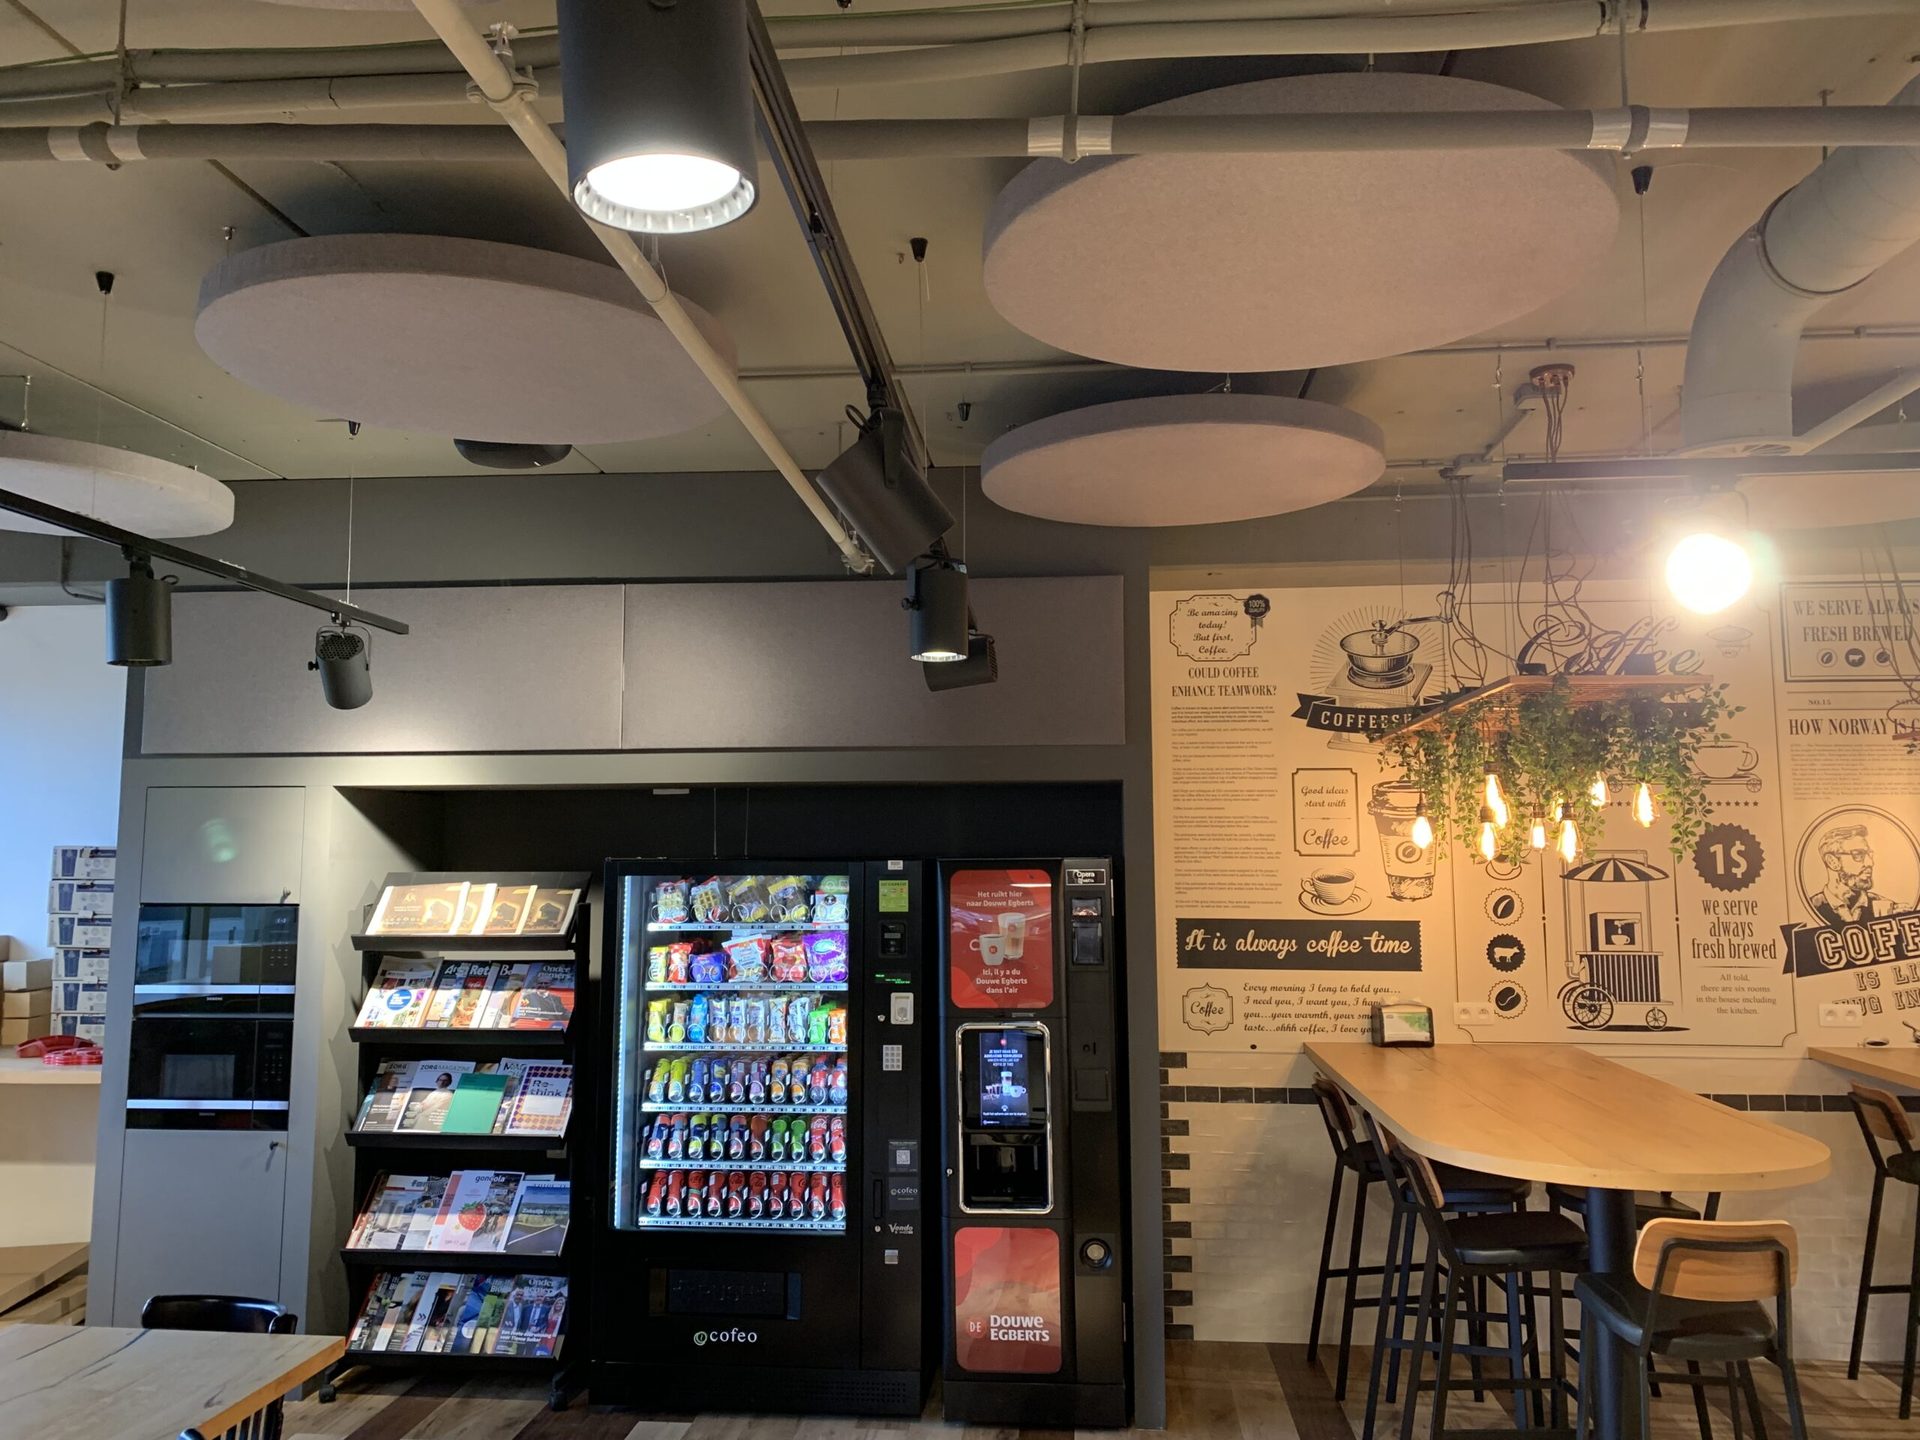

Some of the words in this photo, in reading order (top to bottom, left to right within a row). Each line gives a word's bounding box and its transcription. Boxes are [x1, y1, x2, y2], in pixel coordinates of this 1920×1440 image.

[1186, 608, 1199, 616] Be
[1201, 609, 1238, 617] amazing
[1793, 600, 1815, 616] WE
[1819, 599, 1863, 616] SERVE
[1198, 621, 1227, 631] today!
[1193, 633, 1210, 642] But
[1212, 633, 1234, 643] first,
[1803, 626, 1848, 642] FRESH
[1852, 625, 1913, 642] BREWED
[1188, 667, 1220, 679] COULD
[1223, 666, 1259, 678] COFFEE
[1172, 685, 1216, 697] ENHANCE
[1218, 684, 1277, 696] TEAMWORK?
[1789, 719, 1823, 736] HOW
[1829, 718, 1888, 735] NORWAY
[1300, 786, 1322, 796] Good
[1325, 786, 1349, 795] ideas
[1304, 799, 1324, 808] start
[1326, 799, 1347, 808] with
[1302, 828, 1349, 849] Coffee
[1709, 840, 1748, 878] 1$
[1008, 901, 1034, 909] Egberts
[1702, 900, 1720, 916] we
[1723, 900, 1758, 916] serve
[1709, 916, 1754, 940] always
[1184, 929, 1211, 951] It
[1212, 932, 1227, 951] is
[1235, 930, 1298, 959] always
[1306, 930, 1362, 957] coffee
[1363, 931, 1413, 954] time
[1814, 913, 1920, 969] COFF
[1691, 938, 1726, 959] fresh
[1728, 938, 1777, 960] brewed
[982, 969, 993, 977] Ici,
[1720, 974, 1732, 982] All
[1855, 970, 1880, 991] IS
[1891, 962, 1920, 985] LI
[1001, 978, 1028, 987] Egberts
[1701, 984, 1720, 992] there
[1734, 984, 1746, 992] six
[1243, 983, 1266, 994] Every
[1270, 985, 1305, 995] morning
[1317, 983, 1338, 995] long
[1339, 984, 1349, 993] to
[1350, 983, 1372, 993] hold
[1252, 996, 1273, 1005] need
[1275, 998, 1295, 1008] you,
[1306, 998, 1328, 1006] want
[1330, 998, 1350, 1008] you,
[1705, 994, 1717, 1002] the
[1718, 994, 1741, 1002] house
[1742, 994, 1777, 1004] including
[1190, 1001, 1224, 1018] Coffee
[1717, 1006, 1729, 1015] the
[1294, 1011, 1332, 1020] warmth,
[1333, 1013, 1355, 1022] your
[1299, 1023, 1329, 1034] coffee,
[1339, 1023, 1360, 1033] love
[530, 1089, 562, 1097] think
[897, 1186, 918, 1194] cofeo
[888, 1223, 914, 1233] Vendo
[709, 1327, 758, 1343] cofeo
[990, 1328, 1050, 1342] EGBERTS
